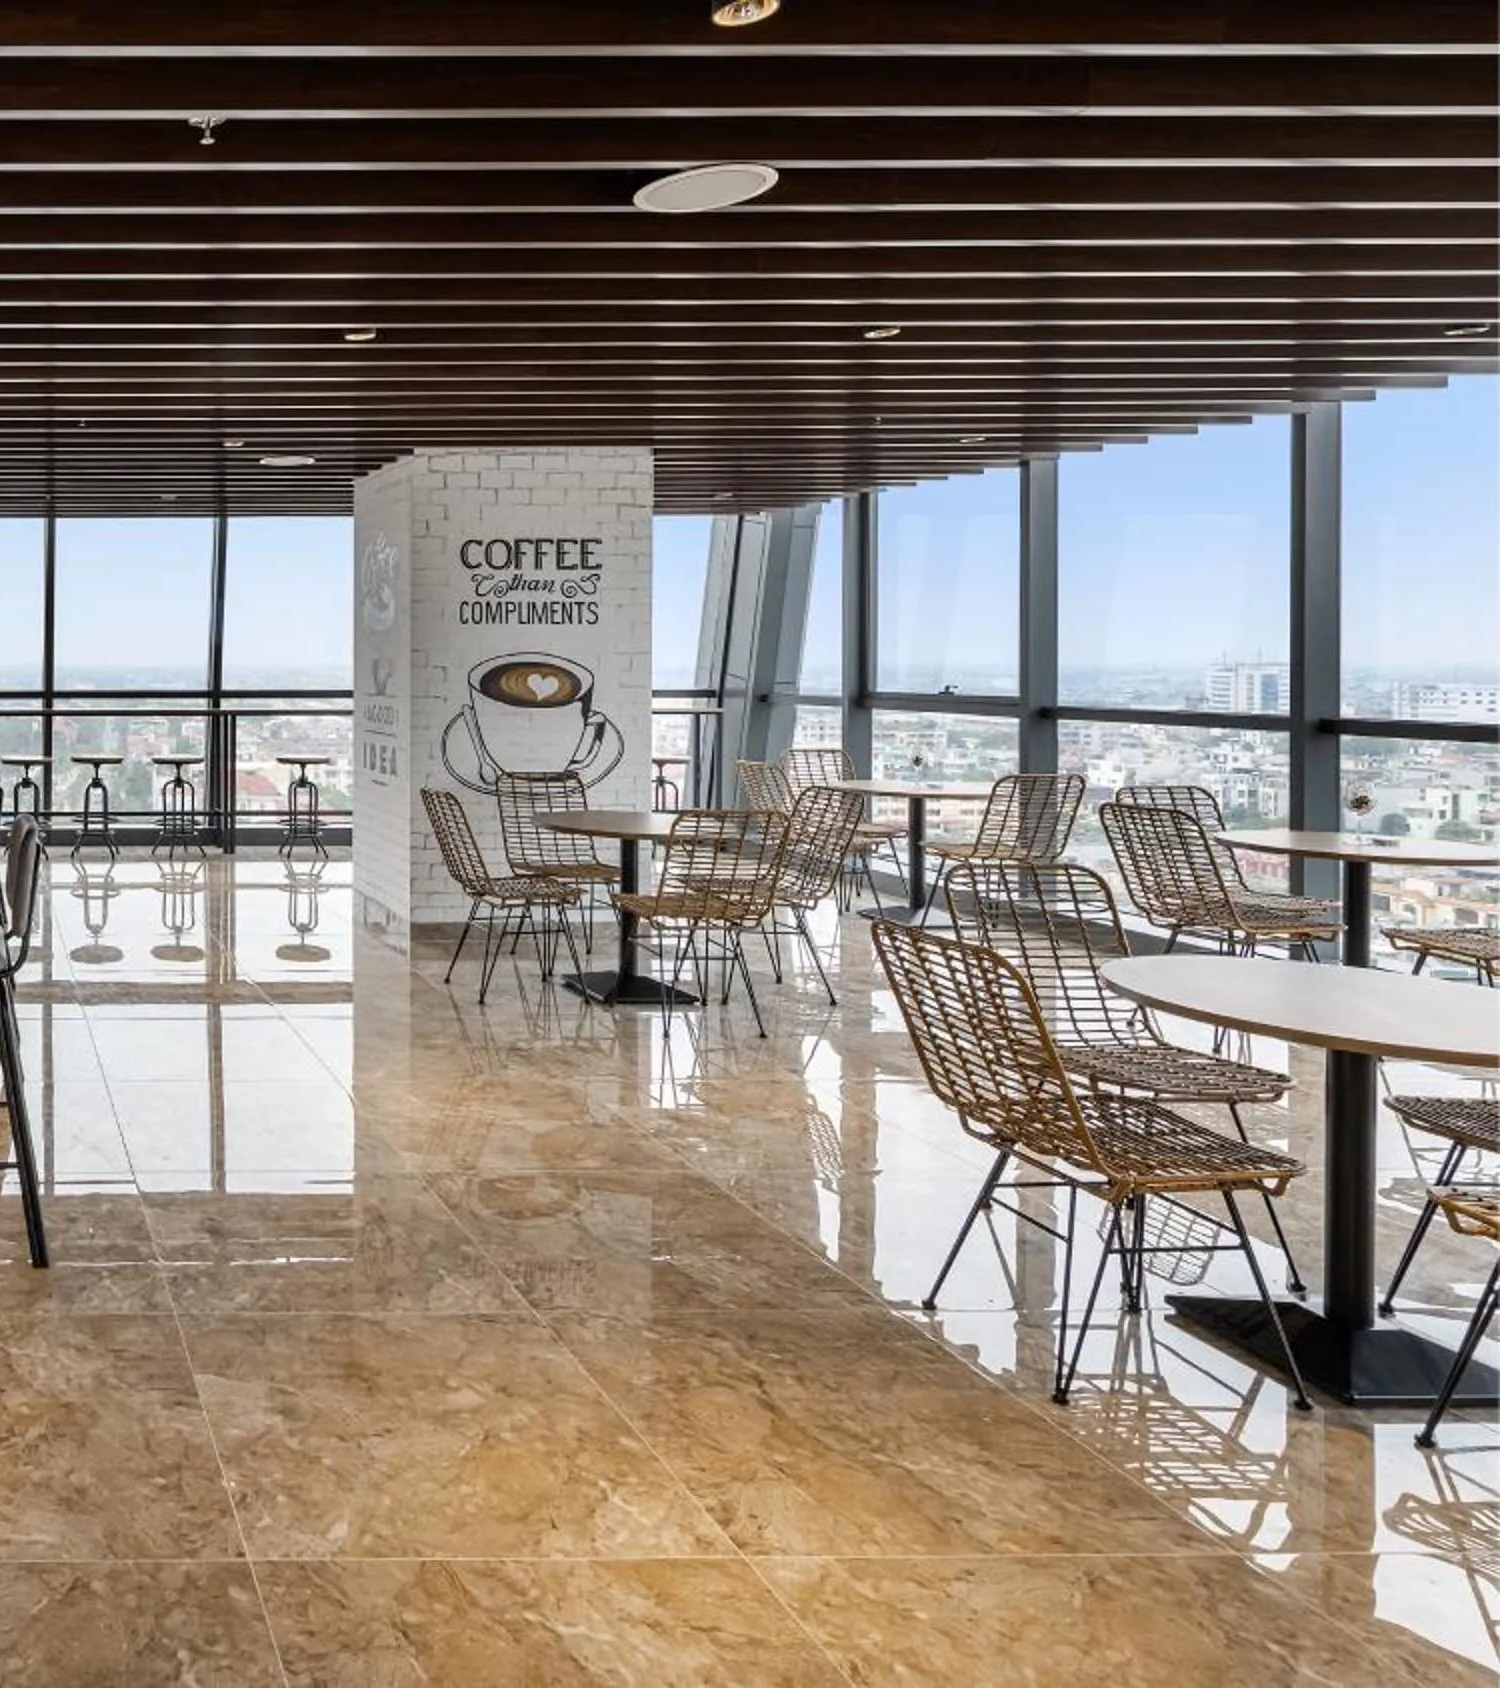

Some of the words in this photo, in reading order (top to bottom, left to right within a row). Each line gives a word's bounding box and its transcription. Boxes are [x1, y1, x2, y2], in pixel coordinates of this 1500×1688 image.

[460, 538, 603, 570] COFFEE
[508, 573, 556, 594] than
[459, 600, 599, 625] COMPLIMENTS
[363, 742, 398, 777] IDEA
